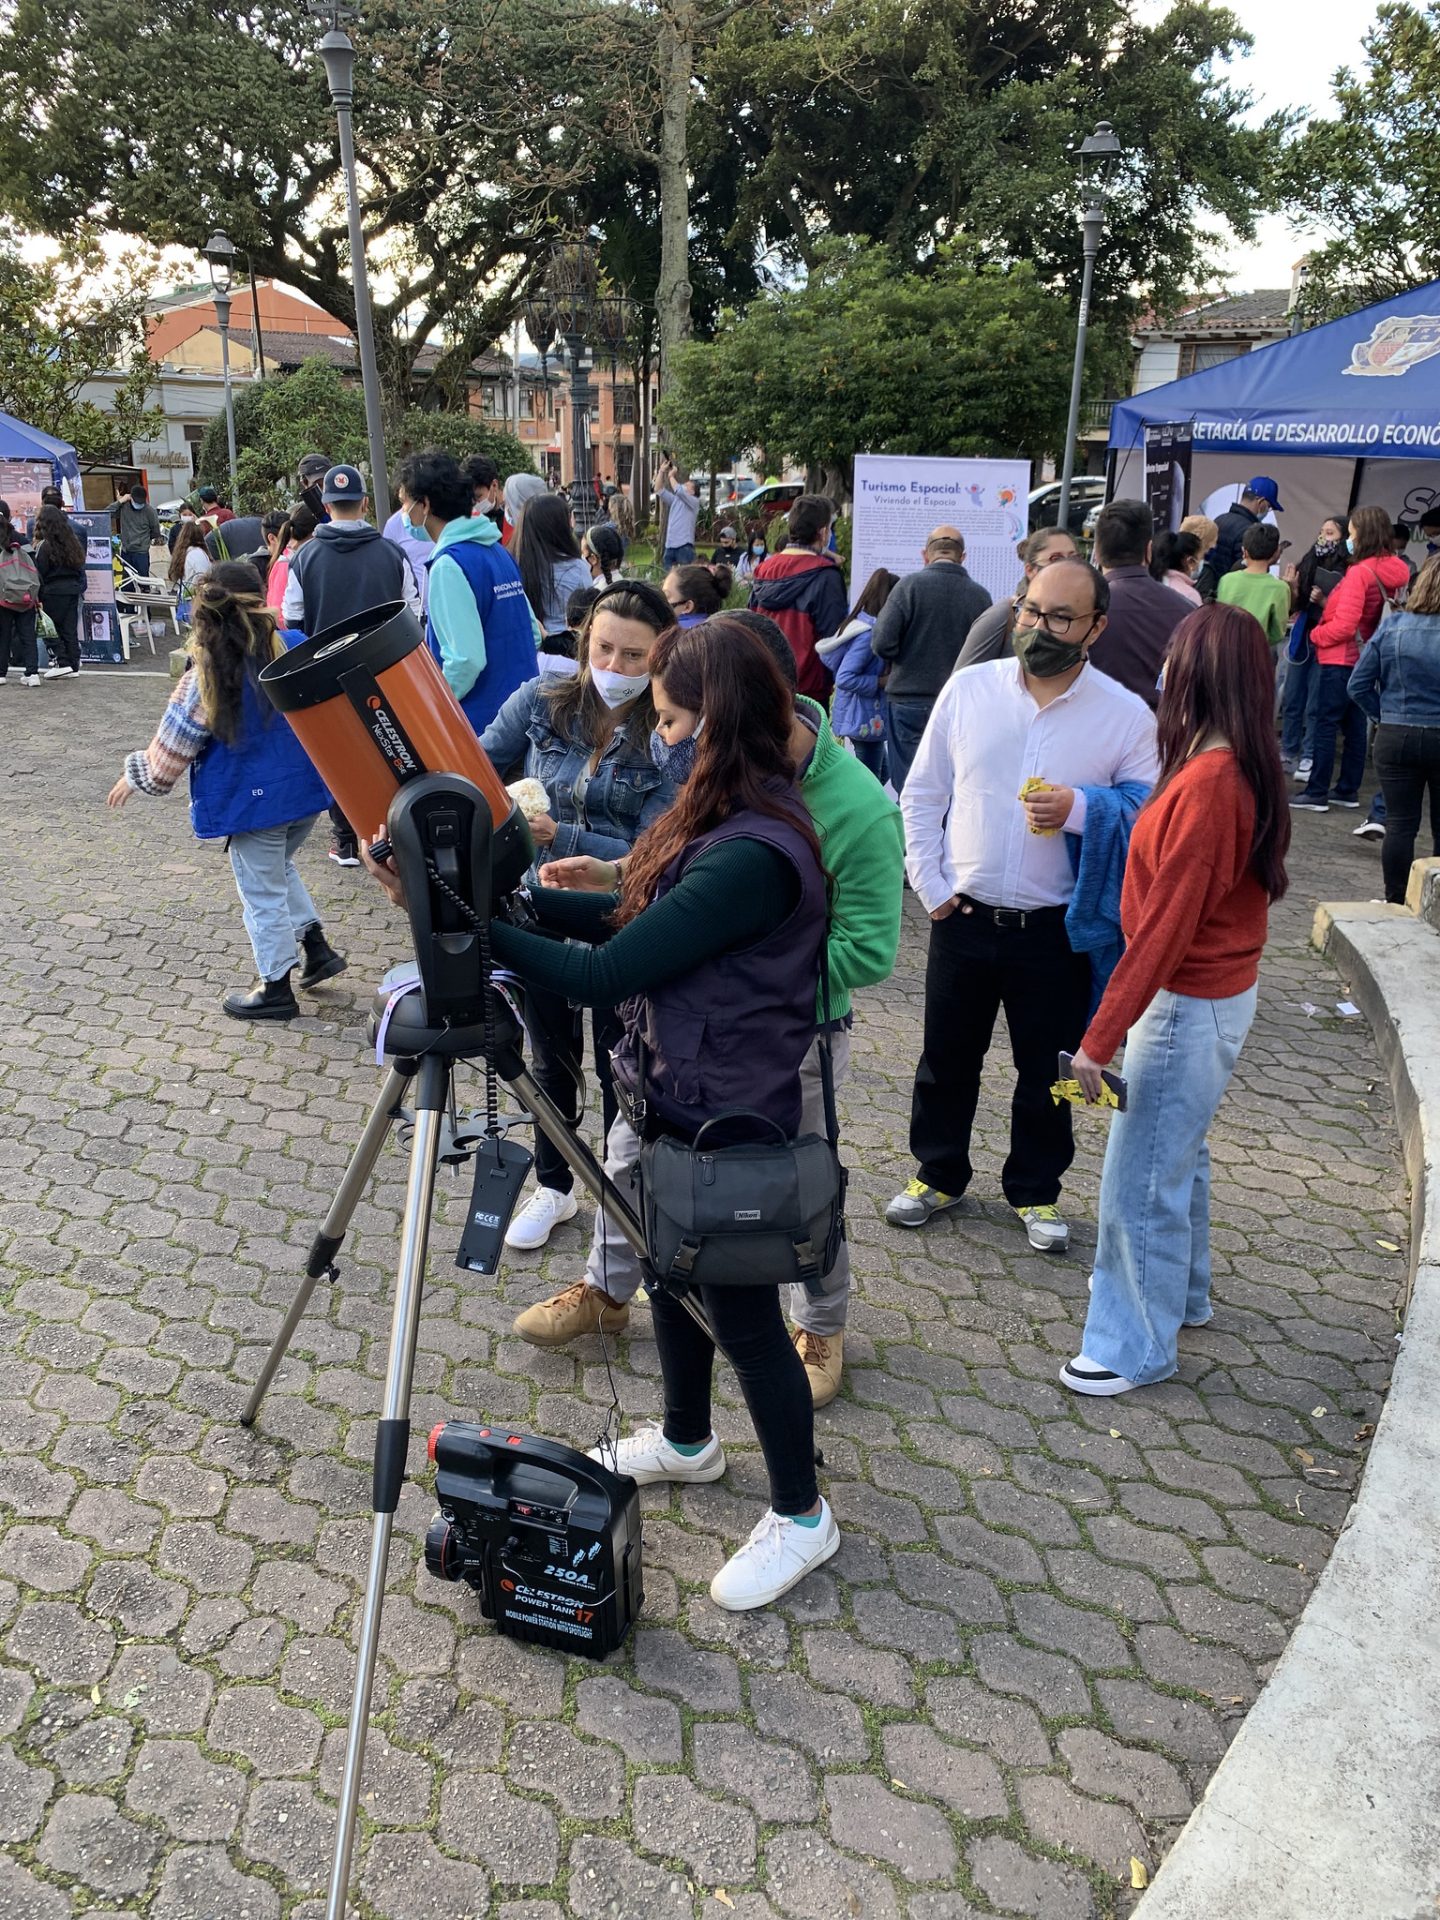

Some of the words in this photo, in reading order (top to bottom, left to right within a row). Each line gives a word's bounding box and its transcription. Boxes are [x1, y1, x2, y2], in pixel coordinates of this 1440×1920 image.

[1192, 418, 1248, 441] RETARÍA
[1252, 422, 1273, 441] DE
[1275, 423, 1379, 444] DESARROLLO
[861, 480, 907, 493] Turismo
[910, 481, 961, 496] Espacial:
[874, 495, 911, 506] Viviendo
[913, 496, 921, 506] el
[923, 497, 957, 508] Espacio
[372, 723, 397, 759] NexStar
[375, 709, 416, 770] CELESTRON
[543, 1565, 588, 1584] 250A
[514, 1594, 549, 1609] POWER
[550, 1603, 576, 1616] TANK
[575, 1609, 594, 1624] 17
[515, 1584, 584, 1609] CELESTRON
[522, 1613, 538, 1625] POWER
[538, 1617, 557, 1630] STATION
